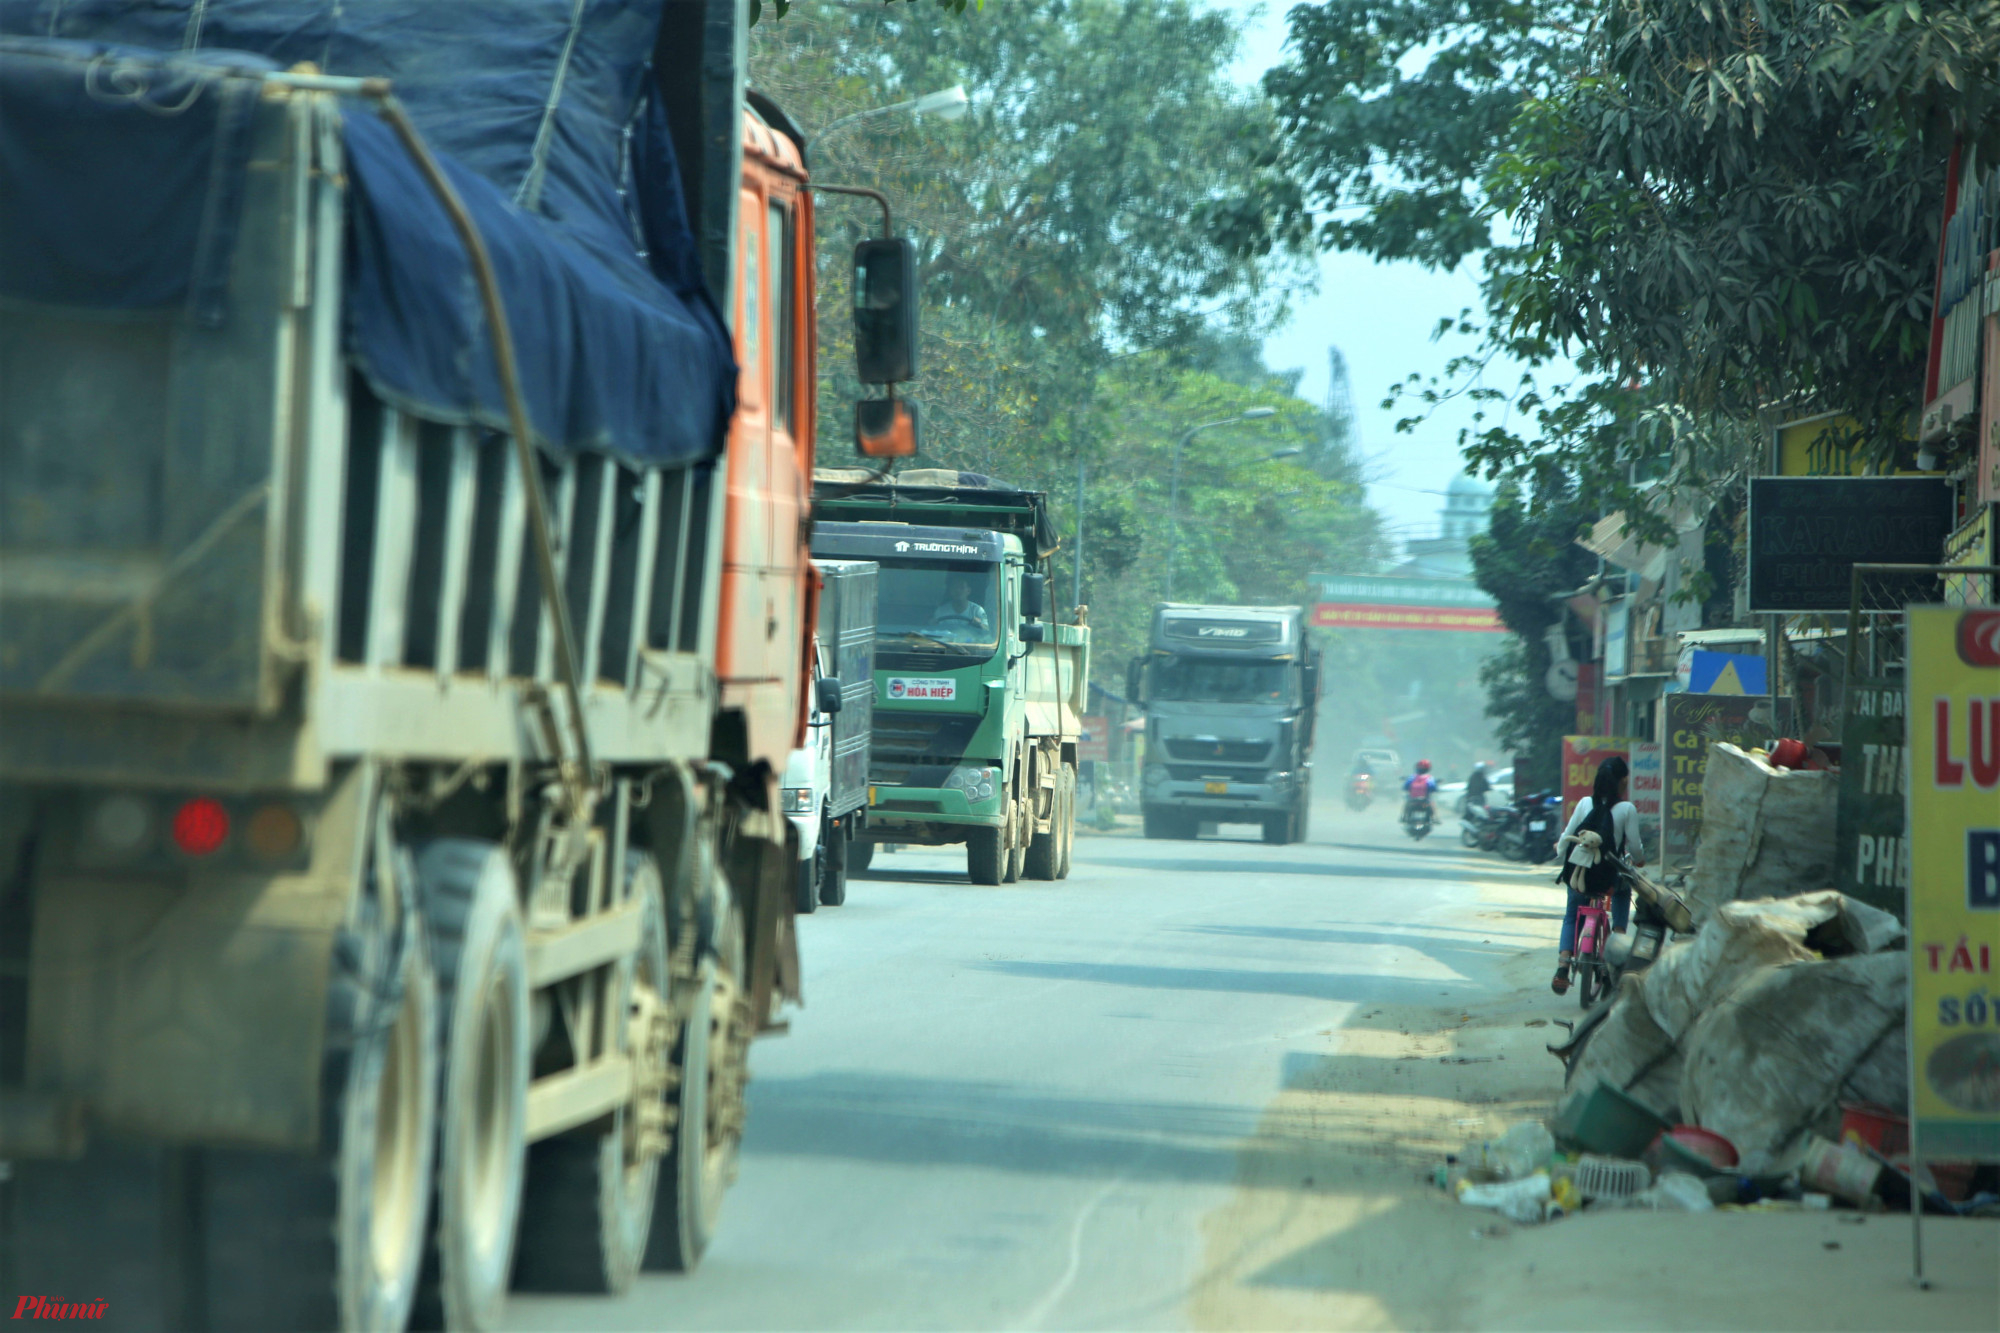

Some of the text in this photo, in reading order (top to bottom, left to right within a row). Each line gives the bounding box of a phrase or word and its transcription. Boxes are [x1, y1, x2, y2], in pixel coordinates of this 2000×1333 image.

[1761, 515, 1944, 556] KARAOKE
[1673, 699, 1726, 724] Coffee
[1568, 757, 1597, 787] BÚ
